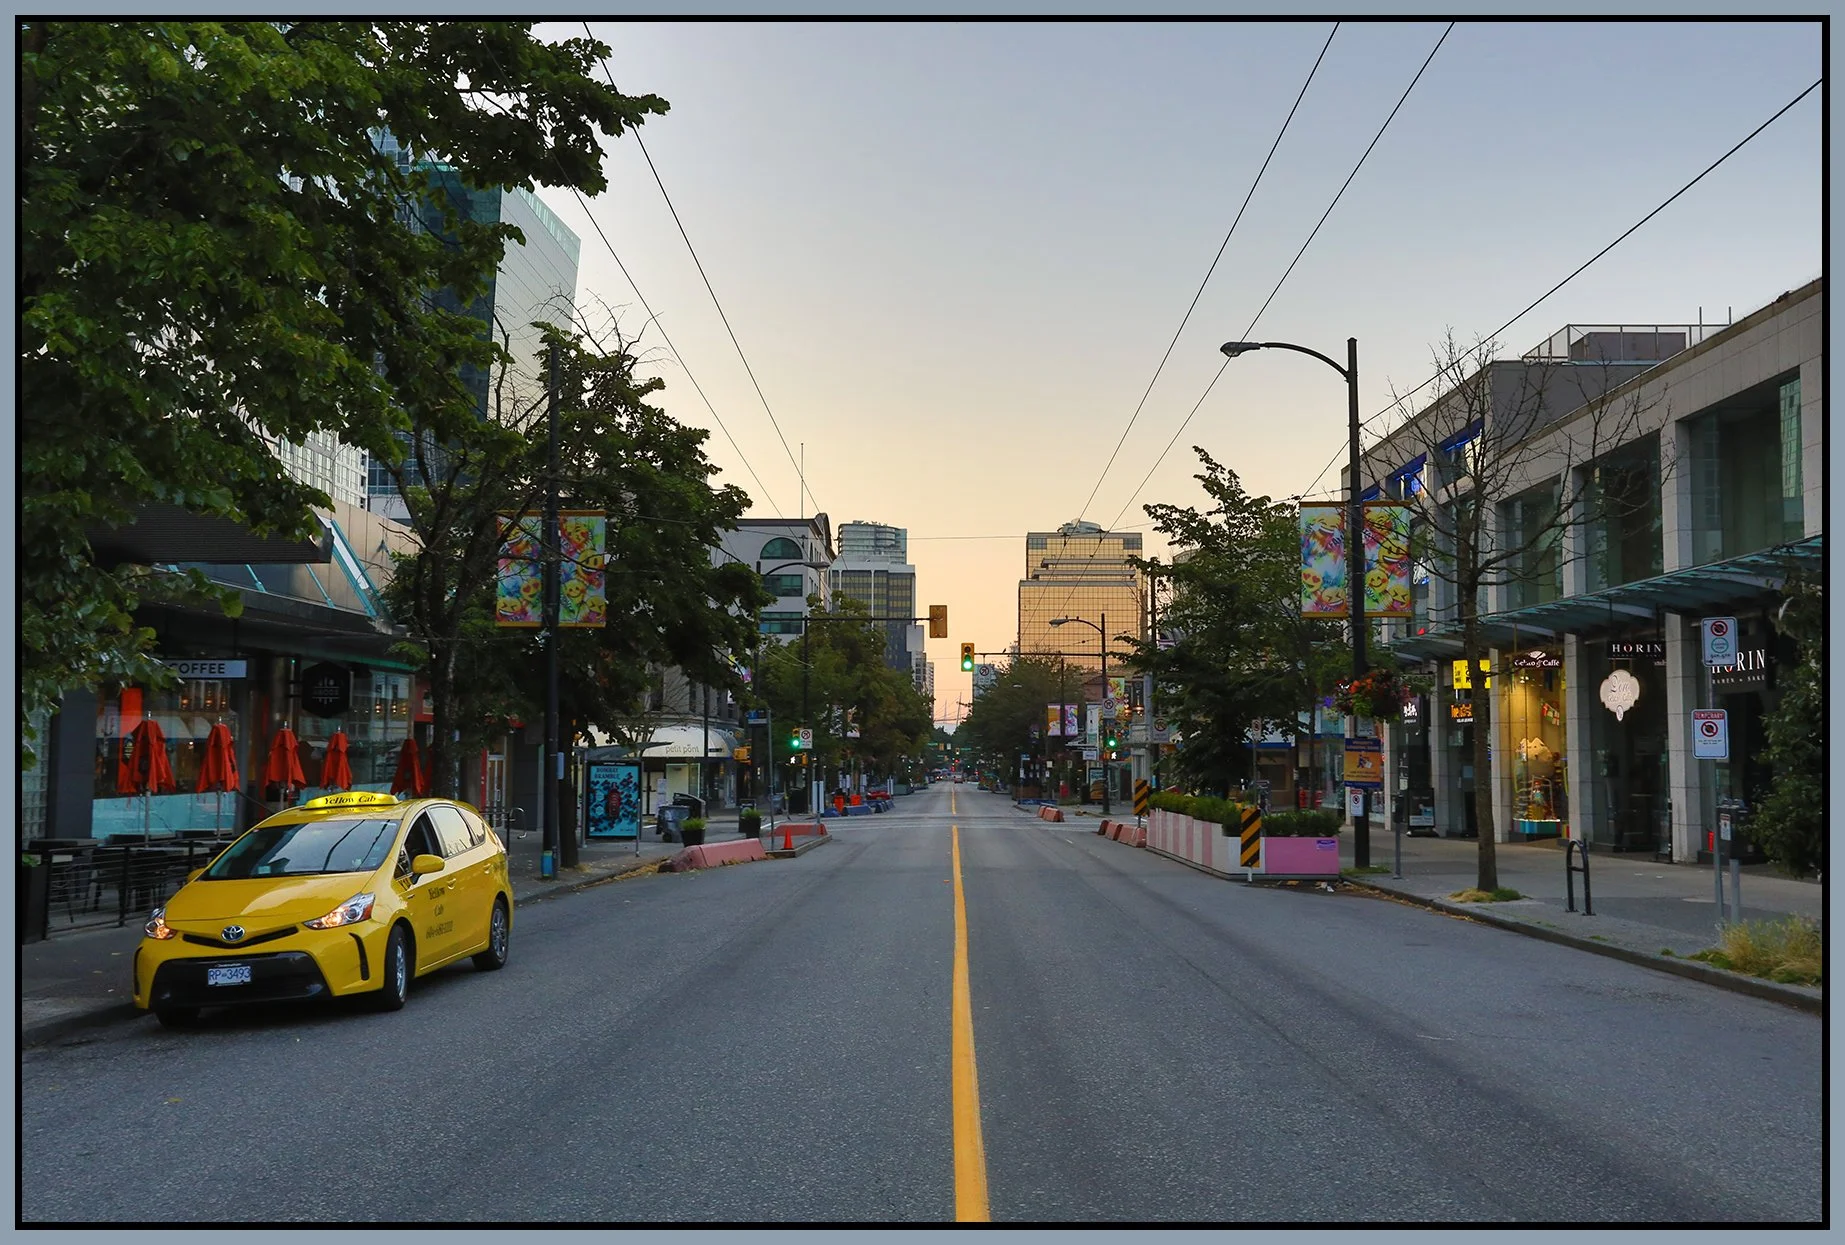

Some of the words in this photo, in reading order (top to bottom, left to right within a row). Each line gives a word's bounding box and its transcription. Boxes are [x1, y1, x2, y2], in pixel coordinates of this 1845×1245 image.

[1612, 644, 1662, 653] HORIN
[665, 744, 682, 754] petit
[324, 797, 354, 805] Yellow
[358, 795, 377, 803] Cab
[428, 886, 446, 901] Yellow
